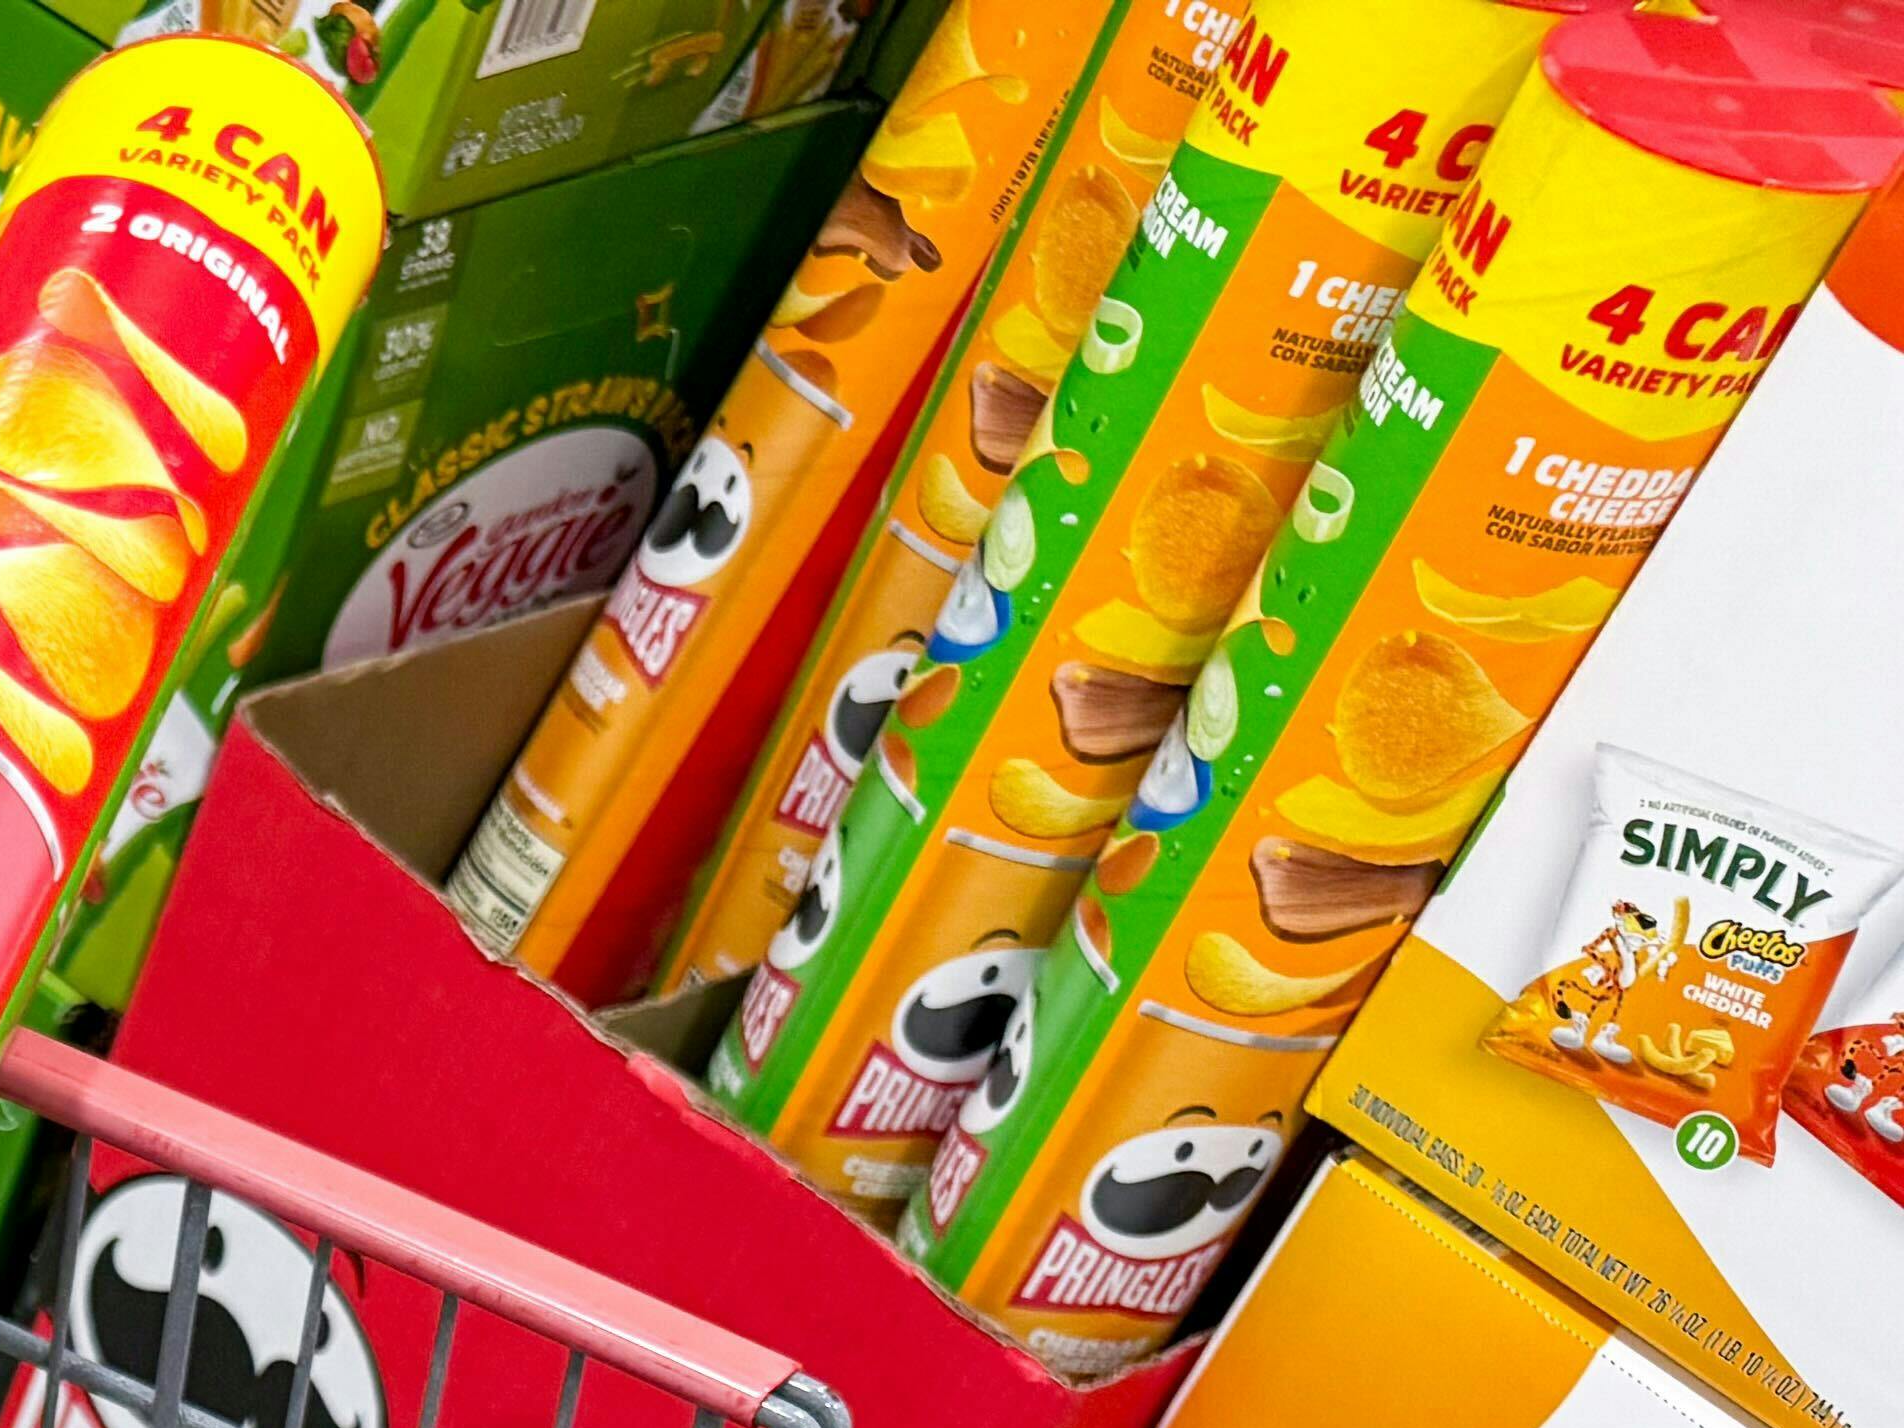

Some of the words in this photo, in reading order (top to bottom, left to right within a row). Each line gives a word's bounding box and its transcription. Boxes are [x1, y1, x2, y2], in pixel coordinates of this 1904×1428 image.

[1146, 62, 1174, 88] CON
[1210, 91, 1259, 147] PACK
[1364, 108, 1430, 171] 4
[136, 105, 192, 143] 4
[214, 123, 340, 261] CAN
[120, 147, 263, 207] VARIETY
[268, 209, 321, 293] PACK
[82, 205, 122, 233] 2
[128, 213, 290, 364] ORIGINAL
[1287, 260, 1319, 299] 1
[1431, 260, 1478, 318] PACK
[1586, 283, 1657, 347] 4
[1269, 344, 1308, 368] CON
[1558, 343, 1715, 400] VARIETY
[364, 408, 517, 551] CLASSIC
[1503, 436, 1538, 476] 1
[1484, 521, 1530, 549] CON
[1526, 532, 1596, 557] SABOR
[1485, 504, 1600, 541] NATURALLY
[387, 489, 634, 651] Veggie
[1620, 818, 1833, 927] SIMPLY
[1699, 919, 1806, 968] Cheetos
[1682, 984, 1773, 1031] CHEDDAR
[1705, 972, 1766, 1008] WHITE
[1686, 1121, 1727, 1164] 10
[1560, 1227, 1600, 1269] TOTAL
[1599, 1254, 1628, 1283] NET
[1622, 1271, 1652, 1303] WT.
[1647, 1288, 1671, 1313] 26
[1718, 1337, 1743, 1365] LB.
[1741, 1352, 1764, 1376] 10
